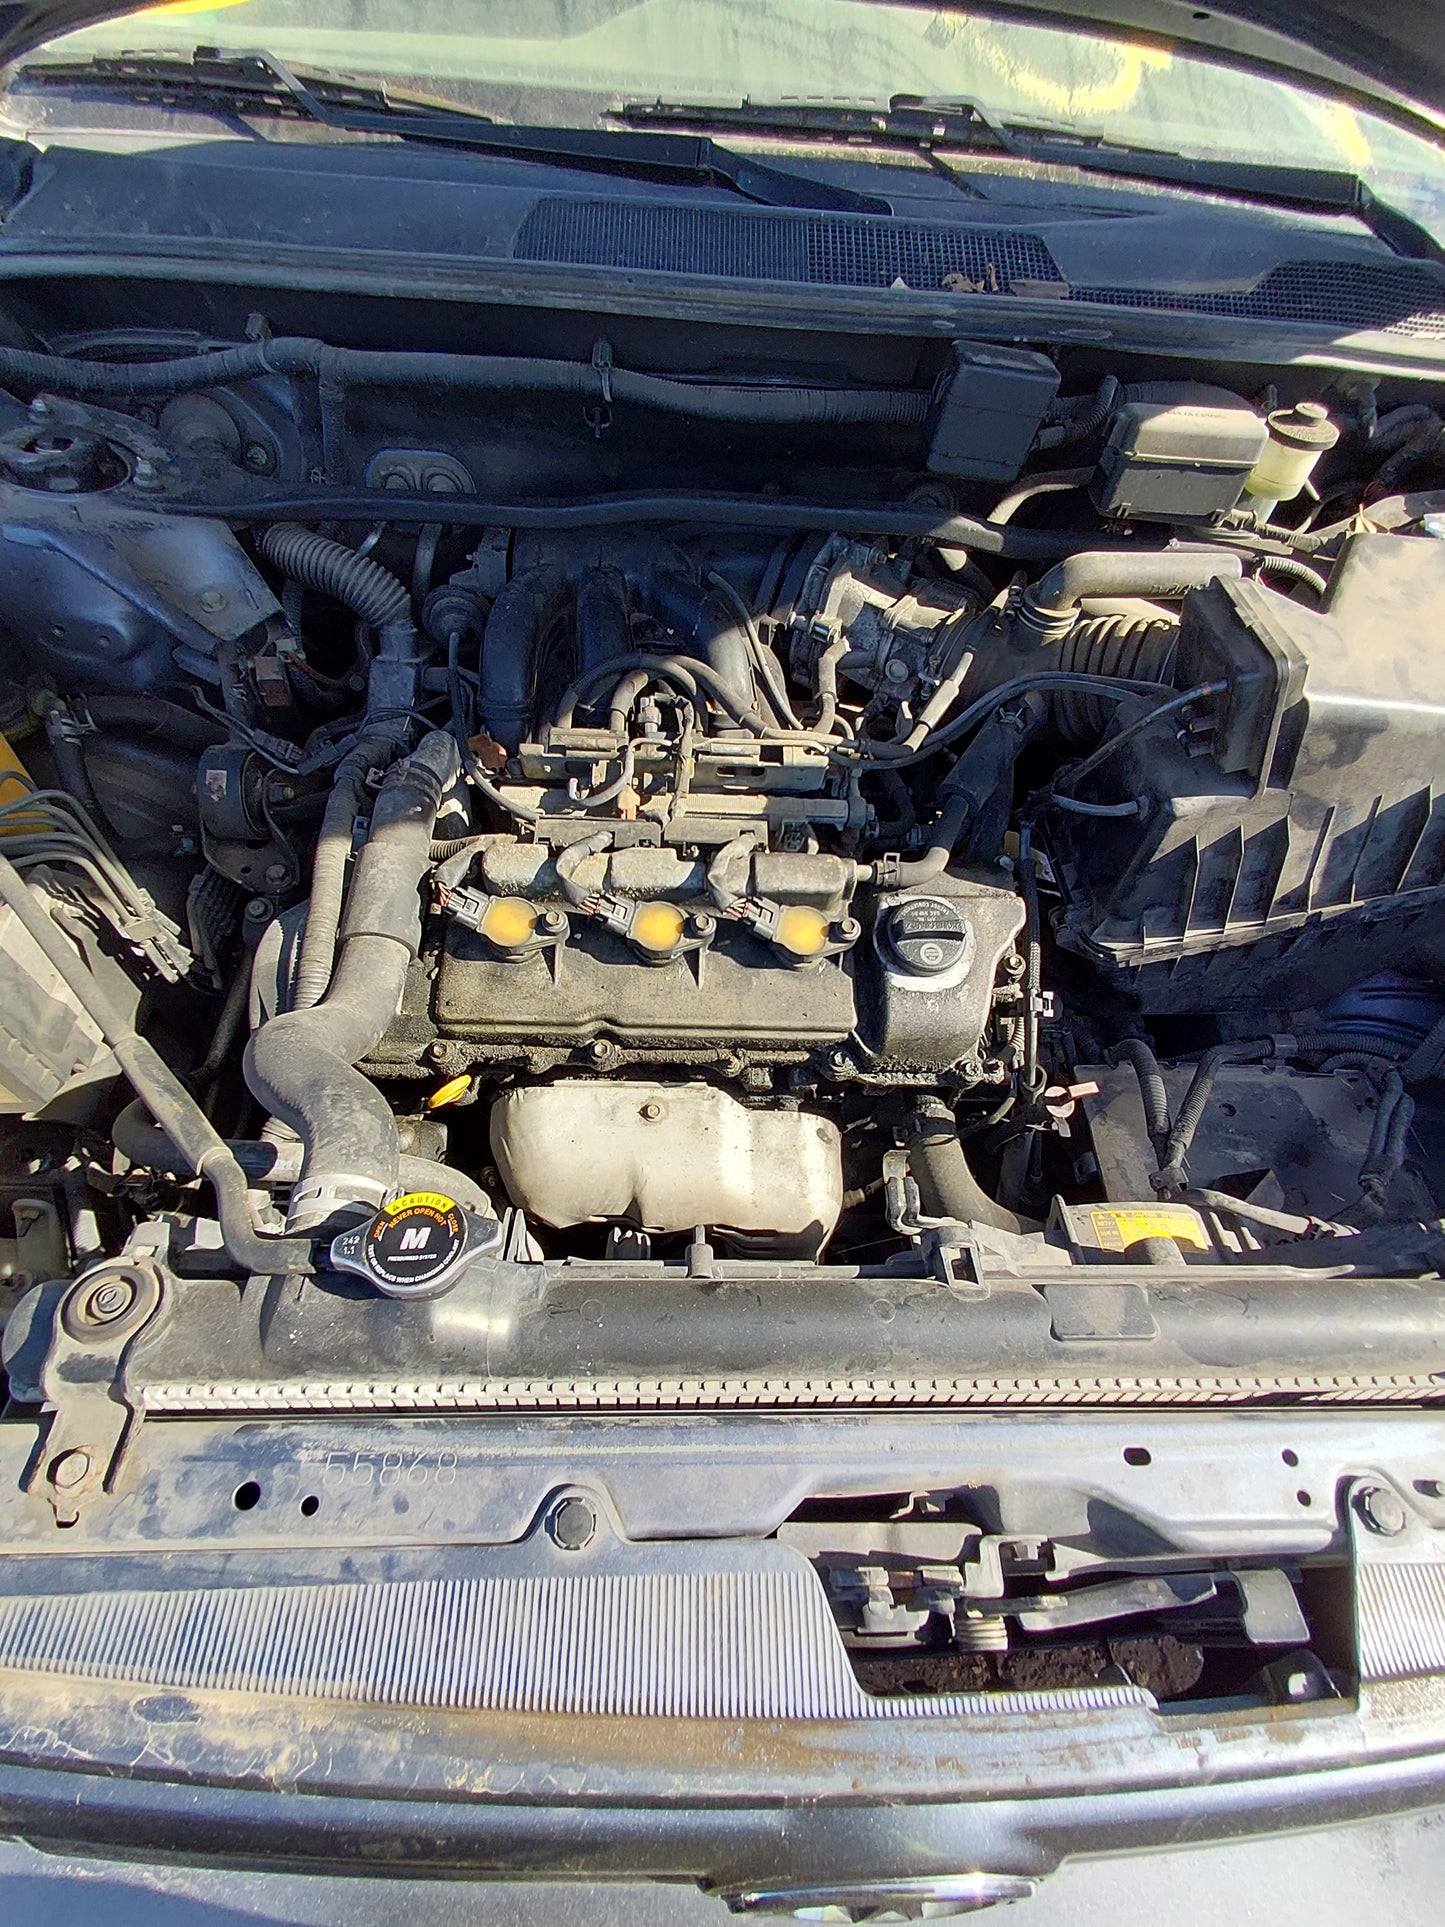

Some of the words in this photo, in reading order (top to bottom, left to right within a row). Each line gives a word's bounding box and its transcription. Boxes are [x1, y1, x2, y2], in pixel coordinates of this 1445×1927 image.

[402, 1196, 448, 1209] CAUTION
[388, 1210, 413, 1229] NEVER
[414, 1208, 434, 1217] OPEN
[433, 1212, 447, 1227] HOT
[447, 1213, 459, 1233] CLOSE
[373, 1221, 386, 1238] OPEN
[400, 1227, 431, 1250] M
[343, 1246, 355, 1255] 1.1
[374, 1266, 397, 1282] REPLACE
[414, 1263, 445, 1282] CHANGING
[443, 1239, 460, 1265] COOLANT
[419, 1253, 438, 1261] SYSTEM
[322, 1451, 458, 1486] 55868
